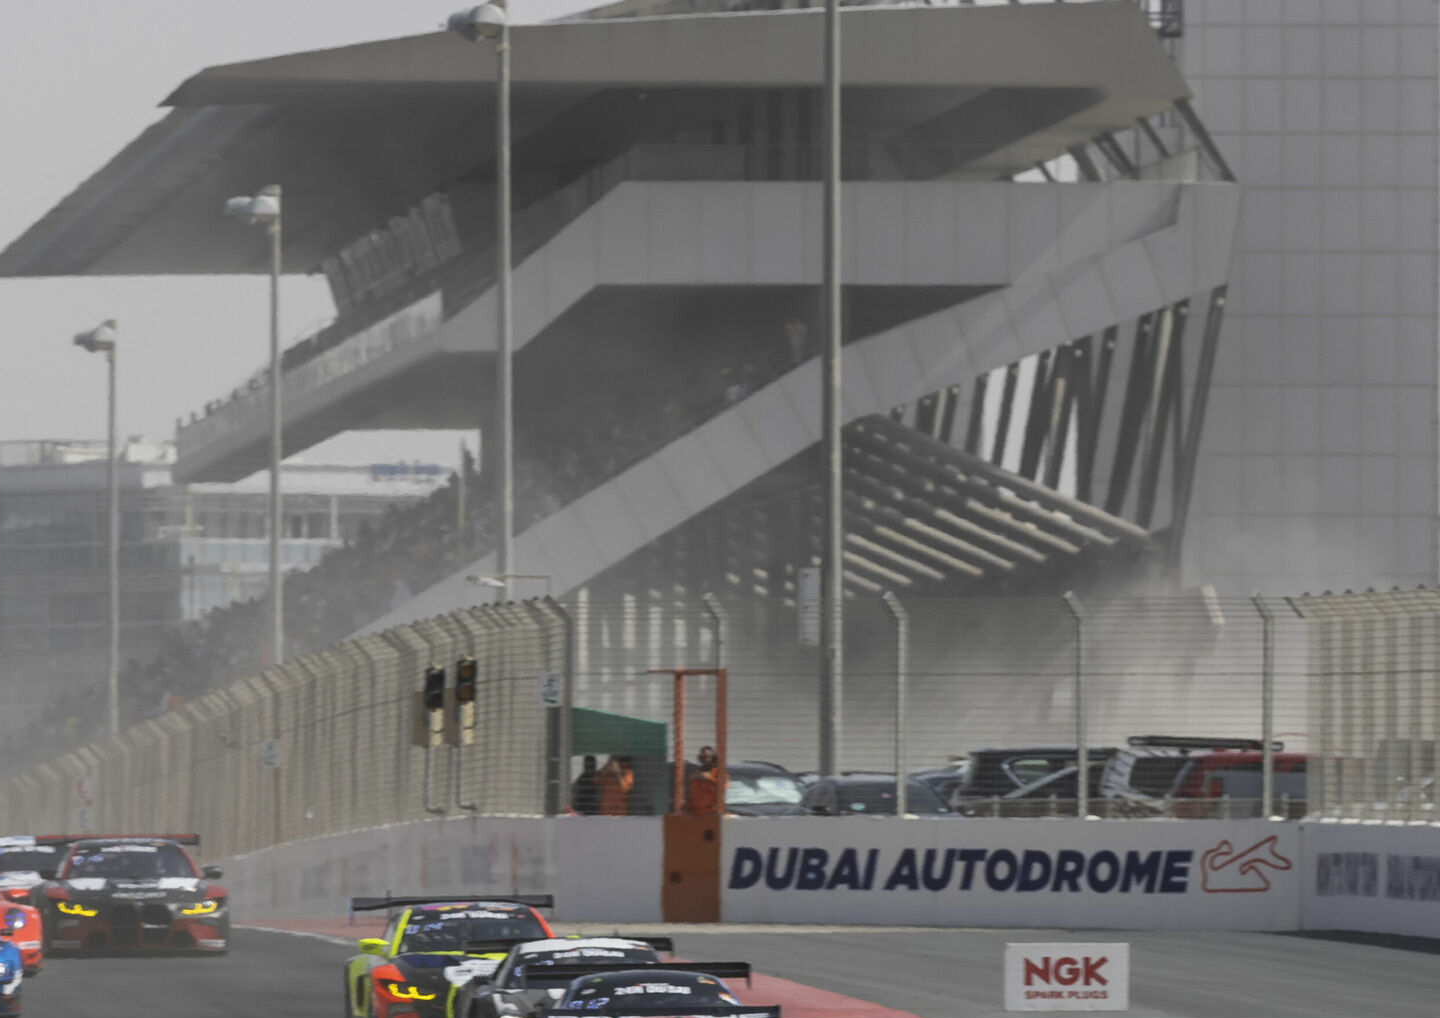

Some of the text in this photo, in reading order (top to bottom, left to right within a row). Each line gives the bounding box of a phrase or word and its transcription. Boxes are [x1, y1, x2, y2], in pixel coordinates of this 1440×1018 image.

[728, 846, 1196, 894] DUBAI AUTODROME
[1023, 956, 1110, 987] NGK
[1024, 991, 1109, 1000] SPARK PLUGS
